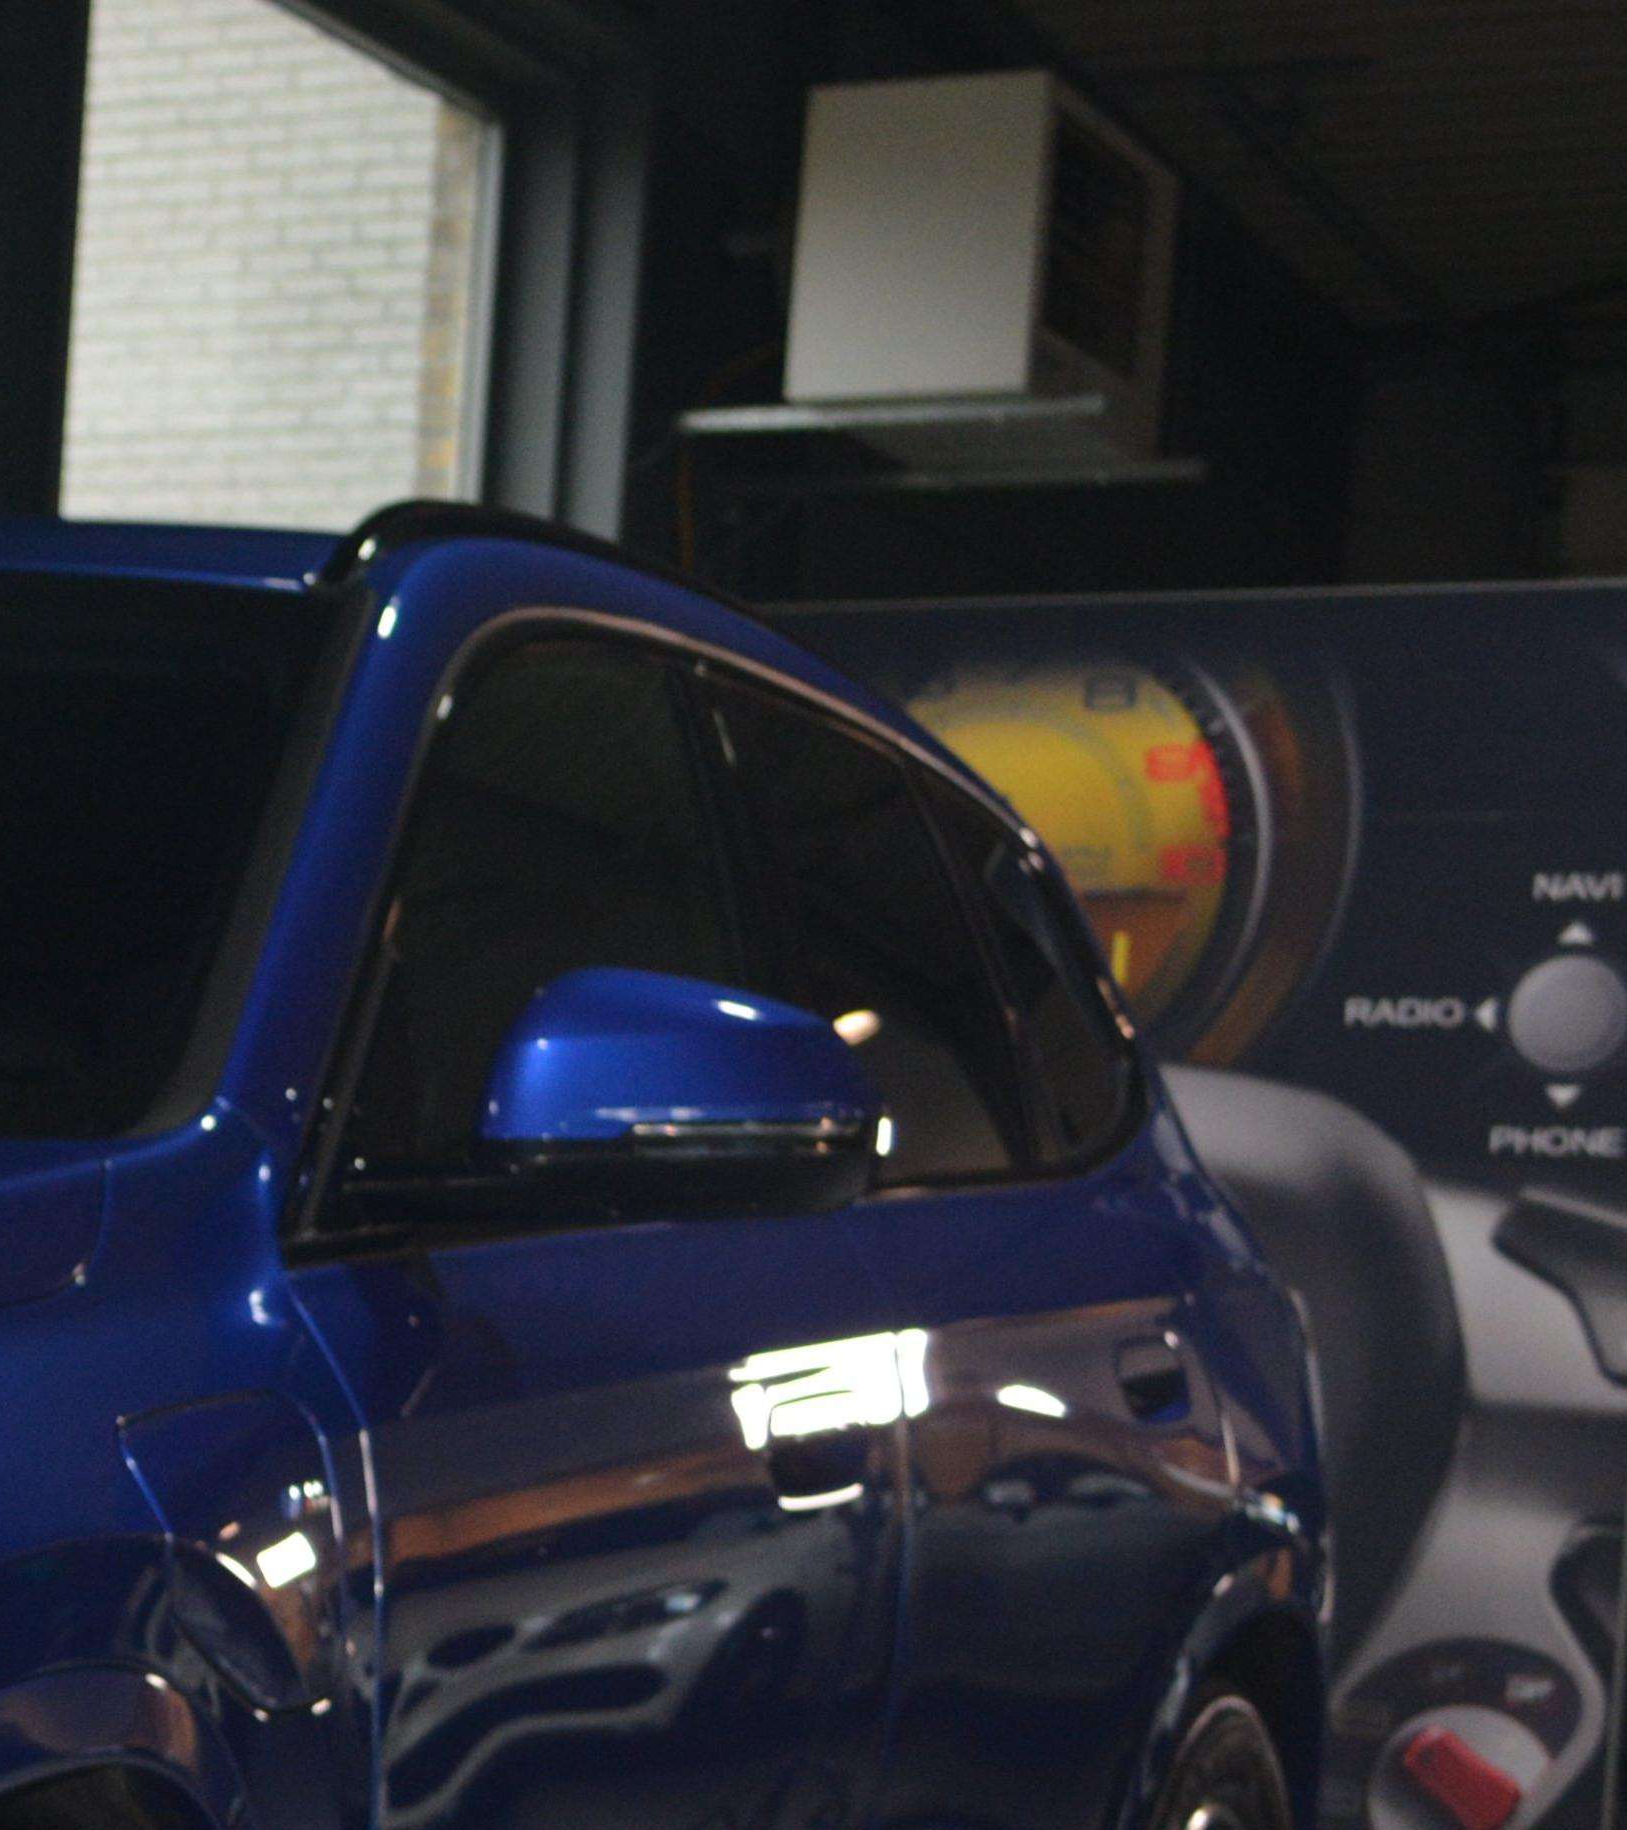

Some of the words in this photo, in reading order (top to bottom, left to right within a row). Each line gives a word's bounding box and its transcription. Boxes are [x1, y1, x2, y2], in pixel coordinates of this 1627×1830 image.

[1531, 871, 1625, 901] NAVI
[1343, 996, 1466, 1029] RADIO
[1488, 1125, 1626, 1158] PHONE
